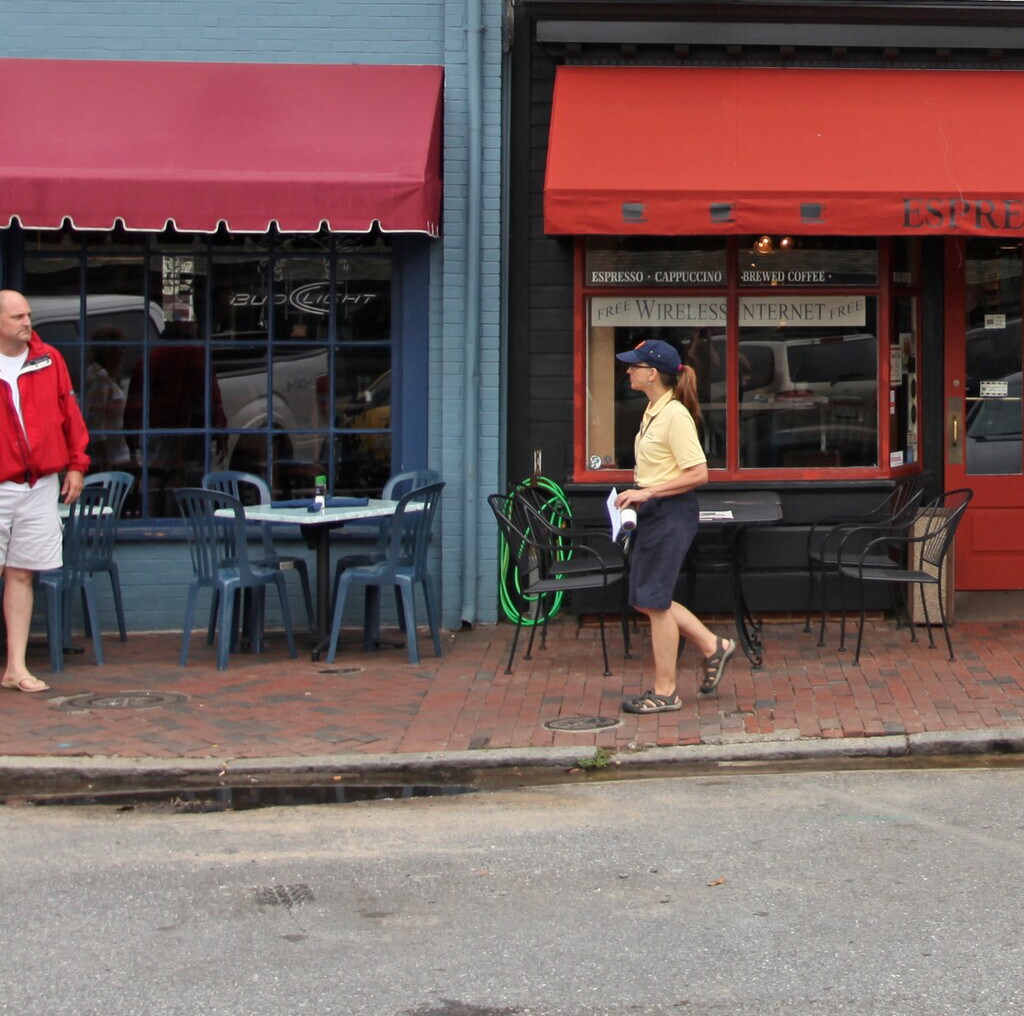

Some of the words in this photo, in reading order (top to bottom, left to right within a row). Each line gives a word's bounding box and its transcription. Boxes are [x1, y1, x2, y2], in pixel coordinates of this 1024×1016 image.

[591, 270, 644, 283] ESPRESSO
[654, 270, 722, 283] CAPPUCCINO
[742, 270, 785, 282] BREWED
[787, 270, 825, 282] COFFEE
[597, 299, 632, 321] FREE
[741, 303, 826, 320] NTERNET
[830, 299, 863, 320] FREE
